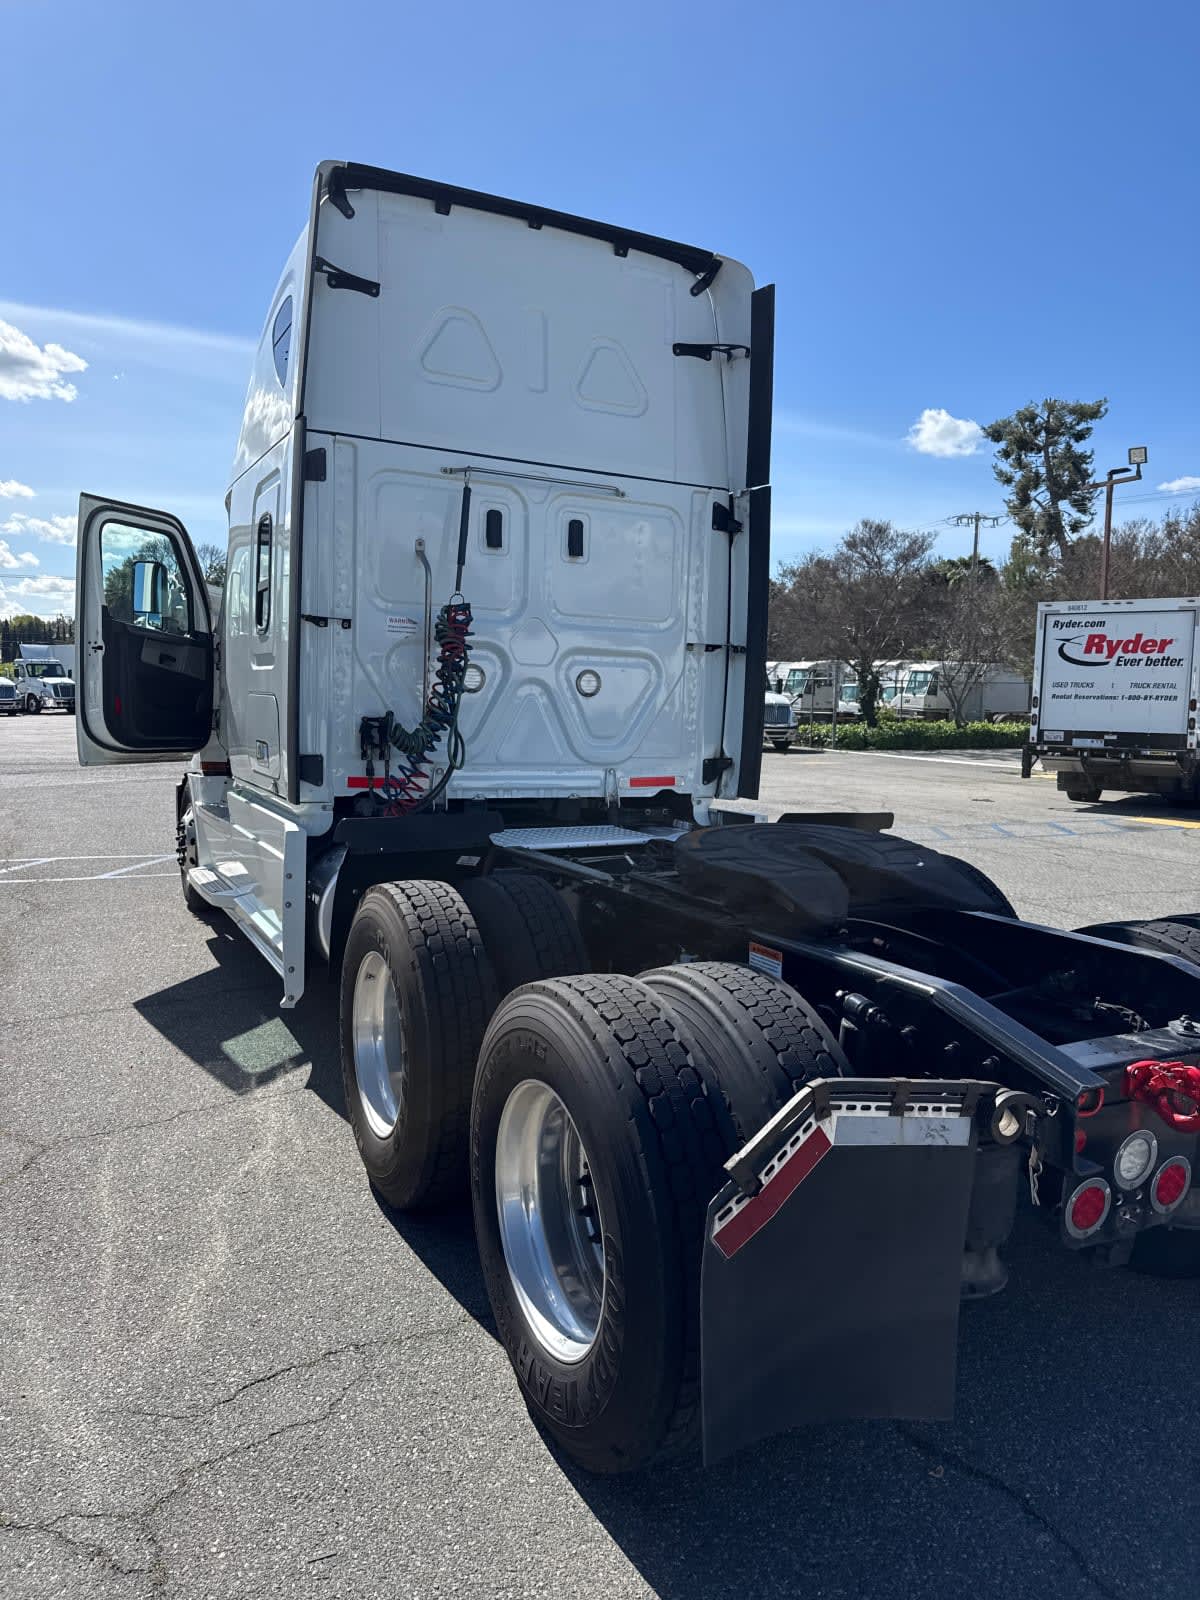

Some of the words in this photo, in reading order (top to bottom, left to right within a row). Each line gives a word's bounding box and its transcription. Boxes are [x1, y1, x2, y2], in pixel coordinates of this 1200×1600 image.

[1052, 619, 1106, 630] Ryder.com
[1083, 633, 1174, 659] Ryder
[1115, 656, 1143, 667] Ever
[1145, 656, 1184, 667] better.
[1052, 681, 1069, 689] USED
[1070, 681, 1095, 689] TRUCKS
[1129, 682, 1151, 690] TRUCK
[1152, 682, 1177, 690] RENTAL
